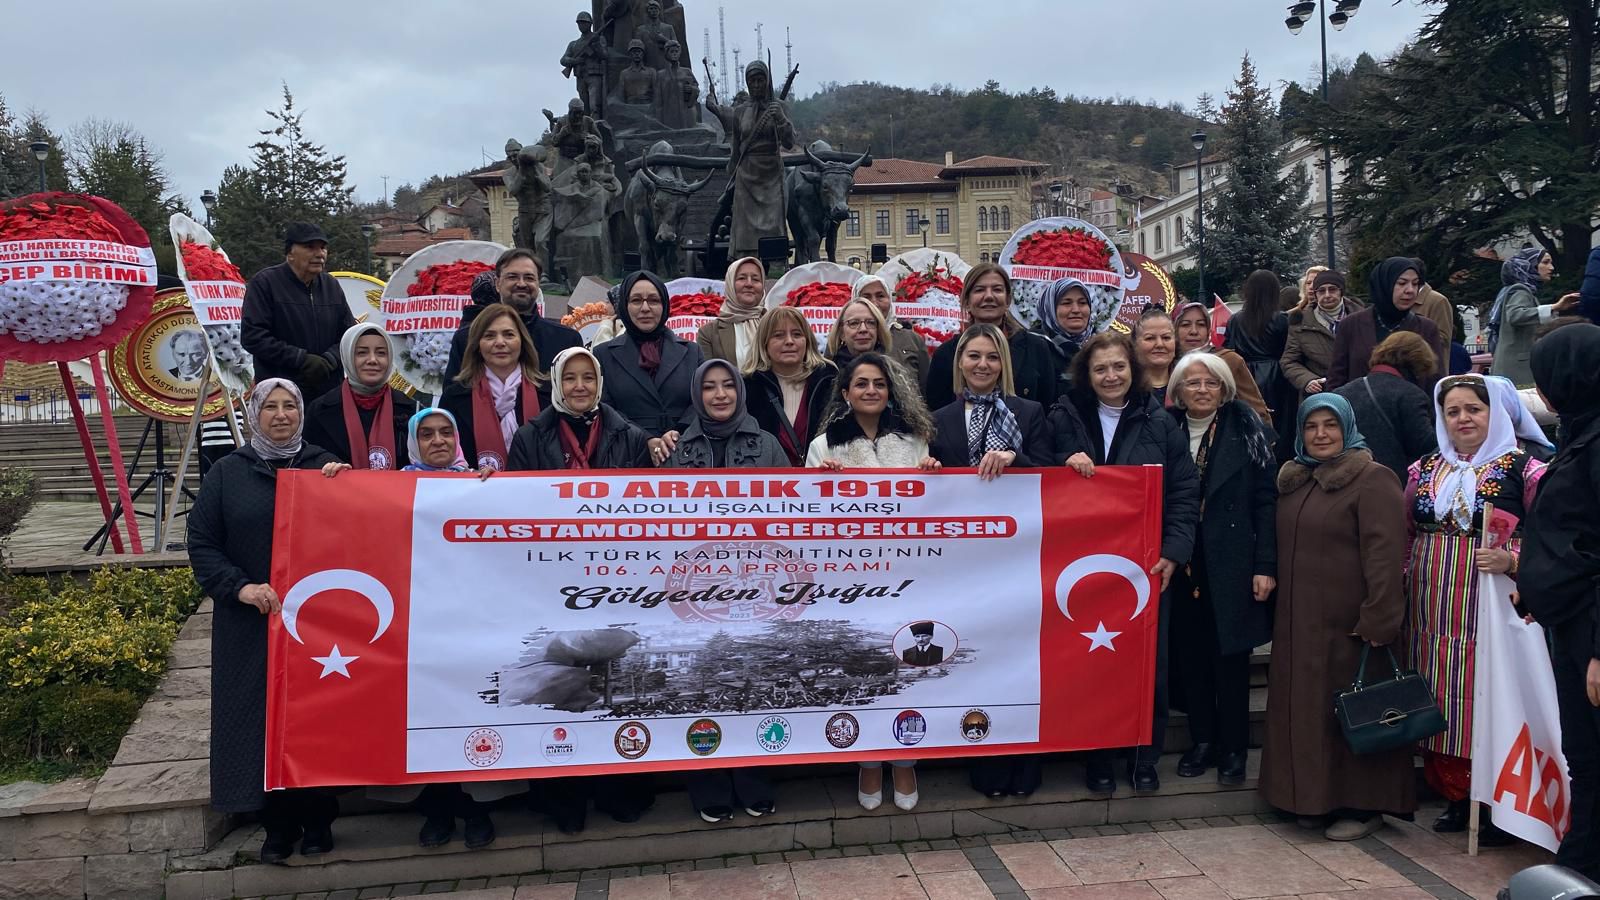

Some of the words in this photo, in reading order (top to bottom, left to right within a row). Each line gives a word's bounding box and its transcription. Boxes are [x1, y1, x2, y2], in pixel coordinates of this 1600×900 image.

[27, 241, 86, 250] HAREKET
[89, 241, 138, 255] PARTİSİ
[44, 250, 56, 259] İL
[53, 263, 148, 283] BİRİMİ
[1011, 266, 1050, 281] CUMHURİYET
[1088, 272, 1104, 284] KADIN
[192, 283, 222, 299] TÜRK
[382, 298, 405, 314] TÜRK
[406, 297, 459, 314] ÜNİVERSİTELİ
[1120, 295, 1152, 305] AFER
[208, 305, 242, 320] KASTA
[895, 305, 930, 316] Kastamonu
[931, 306, 949, 317] Kadın
[550, 481, 609, 498] 10
[622, 480, 801, 498] ARALIK
[811, 479, 926, 498] 1919
[576, 503, 698, 514] ANADOLU
[708, 501, 821, 515] İŞGALİNE
[830, 502, 901, 516] KARŞI
[454, 522, 757, 539] KASTAMONU'DA
[766, 520, 1007, 539] GERÇEKLEŞEN
[527, 549, 574, 562] İLK
[585, 548, 662, 561] TÜRK
[674, 550, 762, 560] KADIN
[776, 545, 943, 559] MİTİNGİ'NİN
[583, 564, 637, 576] 106.
[650, 564, 732, 575] ANMA
[745, 561, 890, 574] PROGRAMI
[559, 583, 760, 611] Gölgeden
[775, 579, 914, 606] Işığa!
